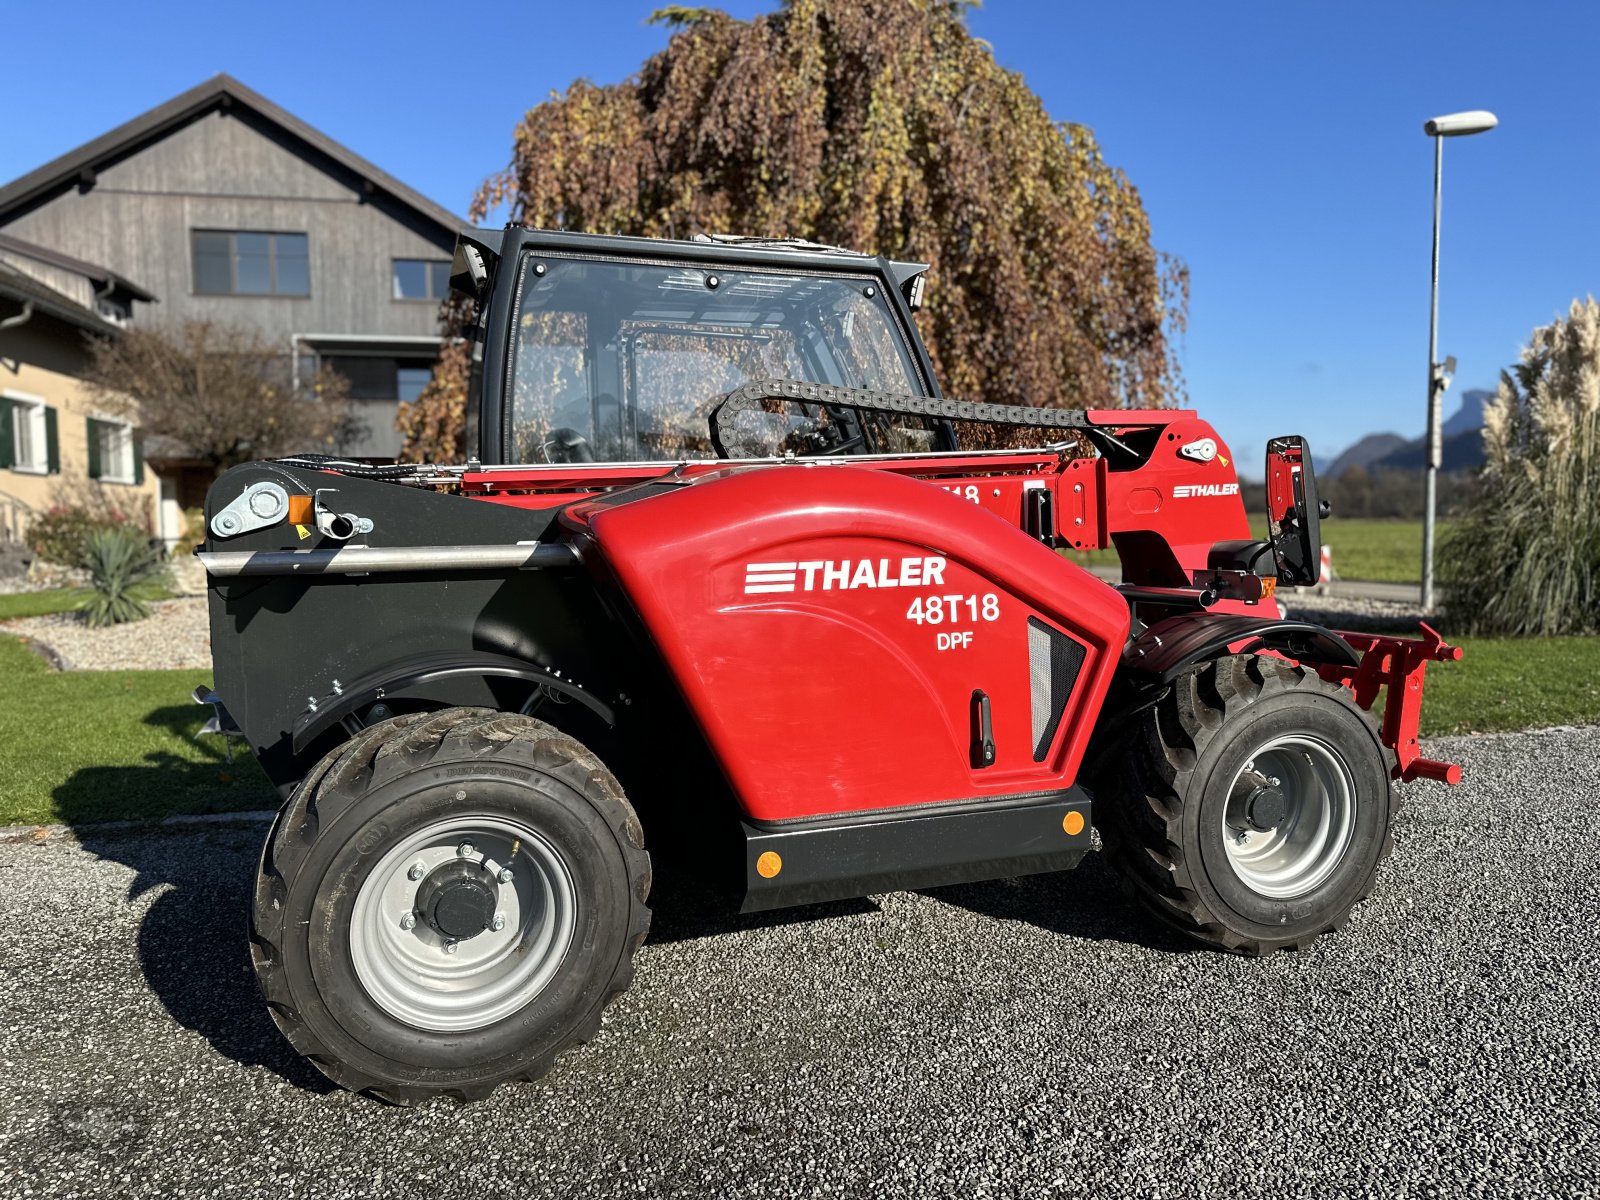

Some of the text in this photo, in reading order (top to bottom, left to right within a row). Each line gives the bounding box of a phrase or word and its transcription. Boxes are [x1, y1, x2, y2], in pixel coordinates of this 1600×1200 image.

[1190, 483, 1239, 497] THALER
[797, 556, 947, 591] THALER
[906, 593, 1000, 625] 48T18
[936, 631, 974, 651] DPF
